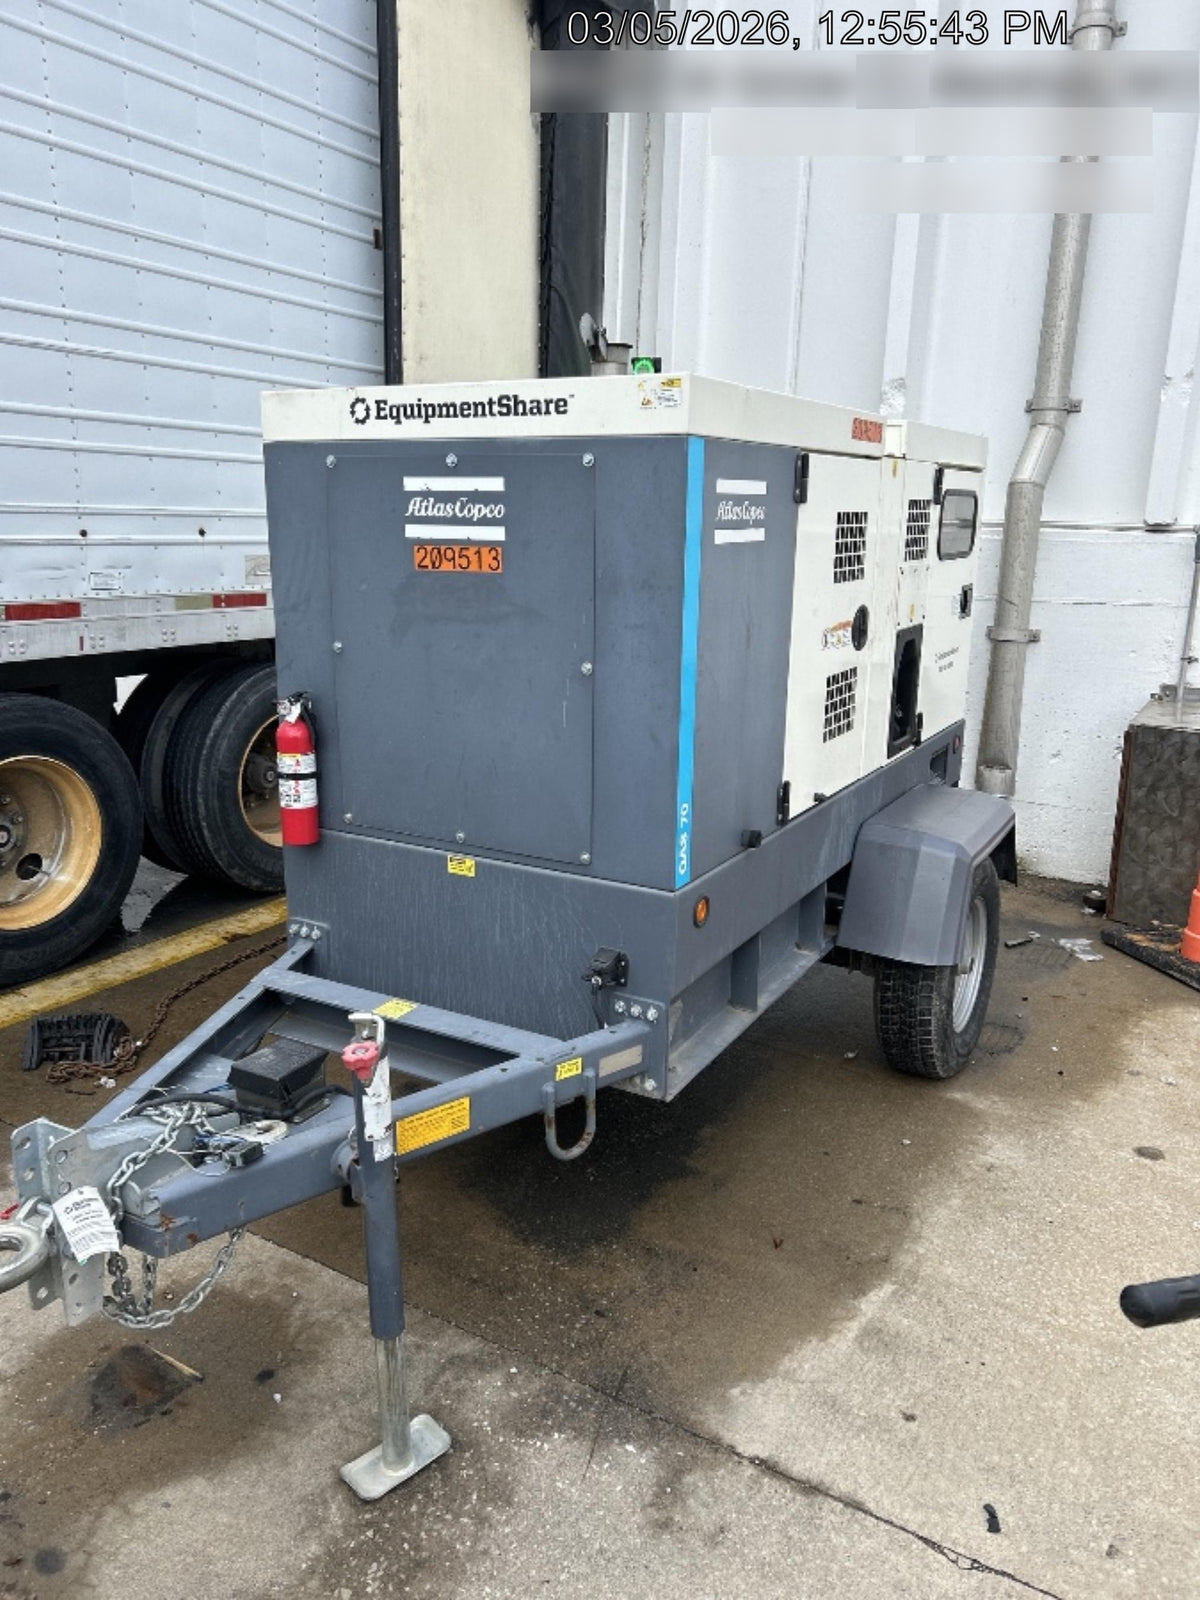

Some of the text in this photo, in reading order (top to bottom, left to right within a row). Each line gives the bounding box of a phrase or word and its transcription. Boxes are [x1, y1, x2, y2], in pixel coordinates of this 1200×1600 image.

[374, 394, 568, 425] EquipmentShare
[416, 546, 501, 571] 209513
[680, 802, 689, 829] 70
